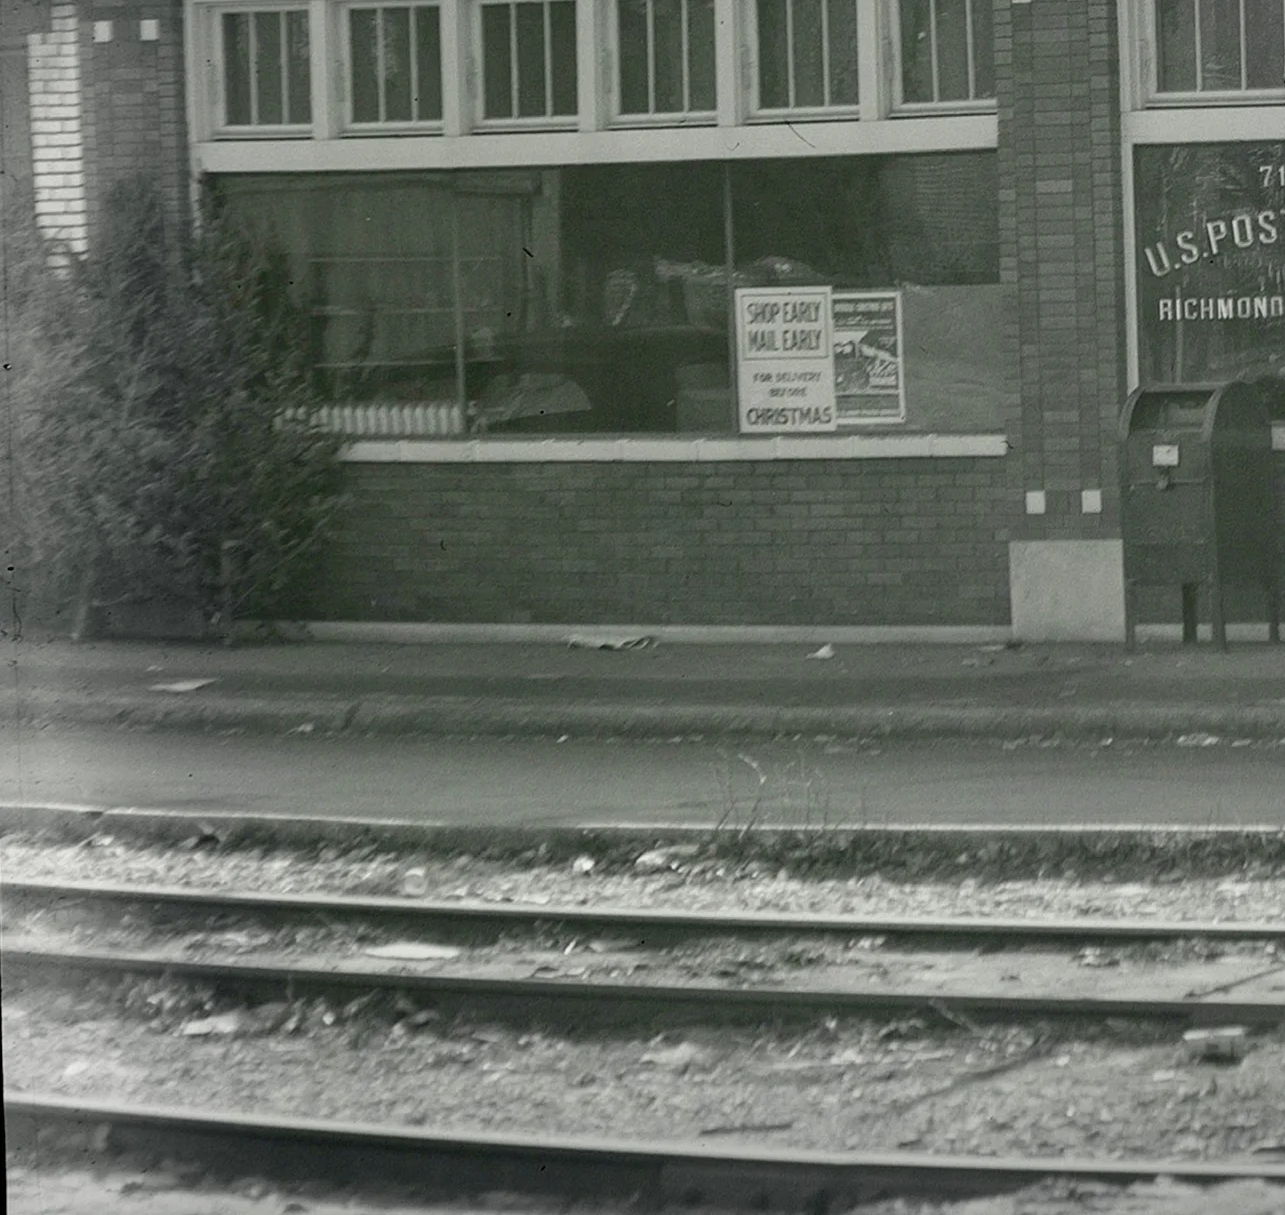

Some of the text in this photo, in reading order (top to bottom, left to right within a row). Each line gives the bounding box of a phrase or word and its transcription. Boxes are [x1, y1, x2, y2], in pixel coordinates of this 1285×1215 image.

[746, 302, 781, 325] SHOP
[782, 301, 822, 324] EARLY
[1158, 295, 1285, 321] RICHMOND
[748, 329, 822, 352] MAIL EARLY
[745, 406, 833, 426] CHRISTMAS
